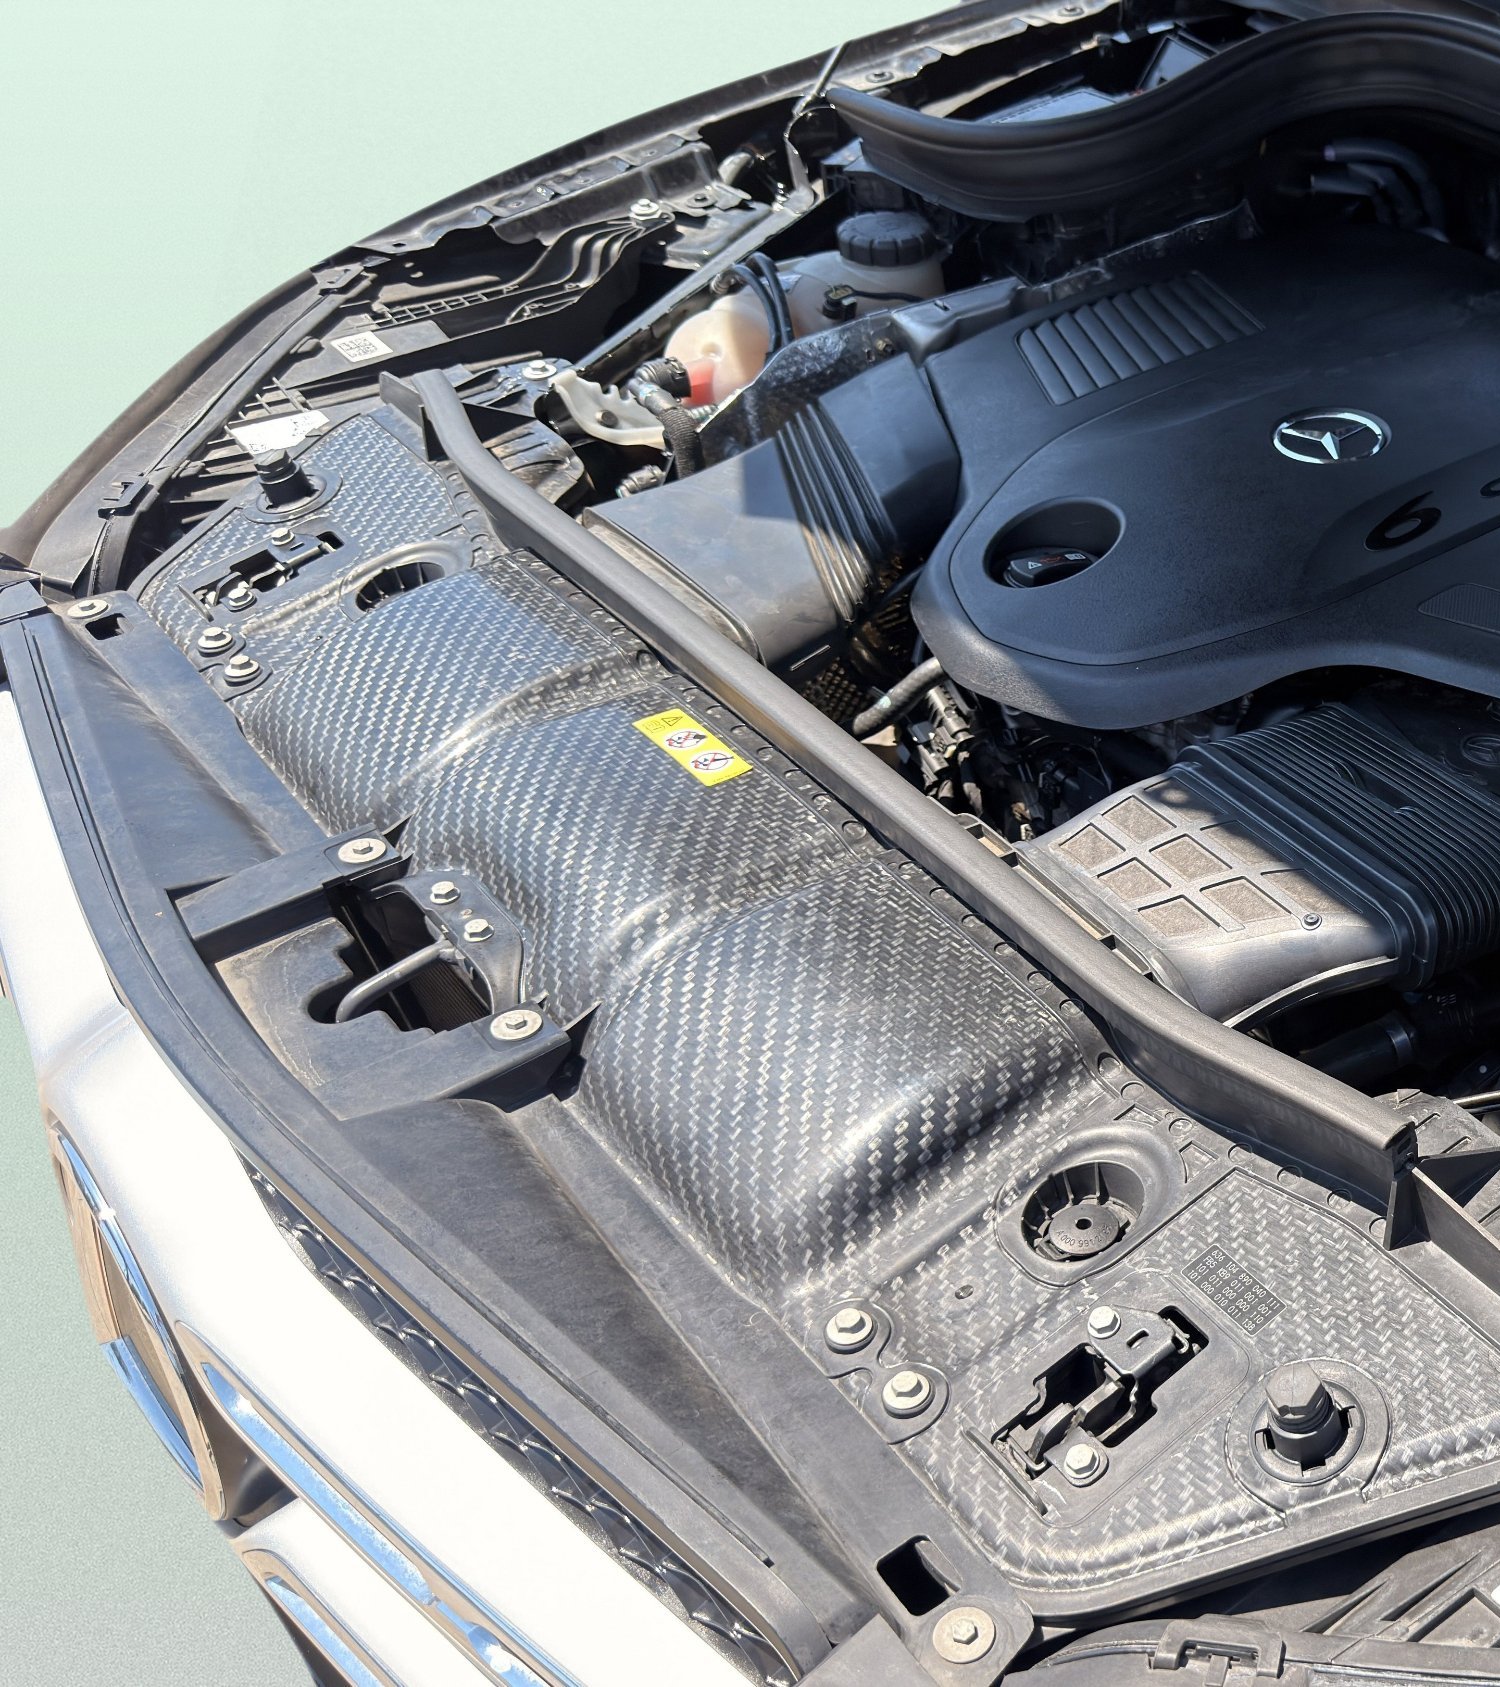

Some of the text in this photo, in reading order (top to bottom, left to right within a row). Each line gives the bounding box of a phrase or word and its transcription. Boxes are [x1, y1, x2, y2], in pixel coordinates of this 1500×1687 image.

[1364, 490, 1441, 552] 6
[1188, 1270, 1255, 1331] 101 000 010 011 138
[1196, 1263, 1263, 1323] 101 011 000 000 110
[1203, 1256, 1271, 1316] FB5 KB9 011 001 001
[1212, 1250, 1280, 1309] 636 104 890 040 111
